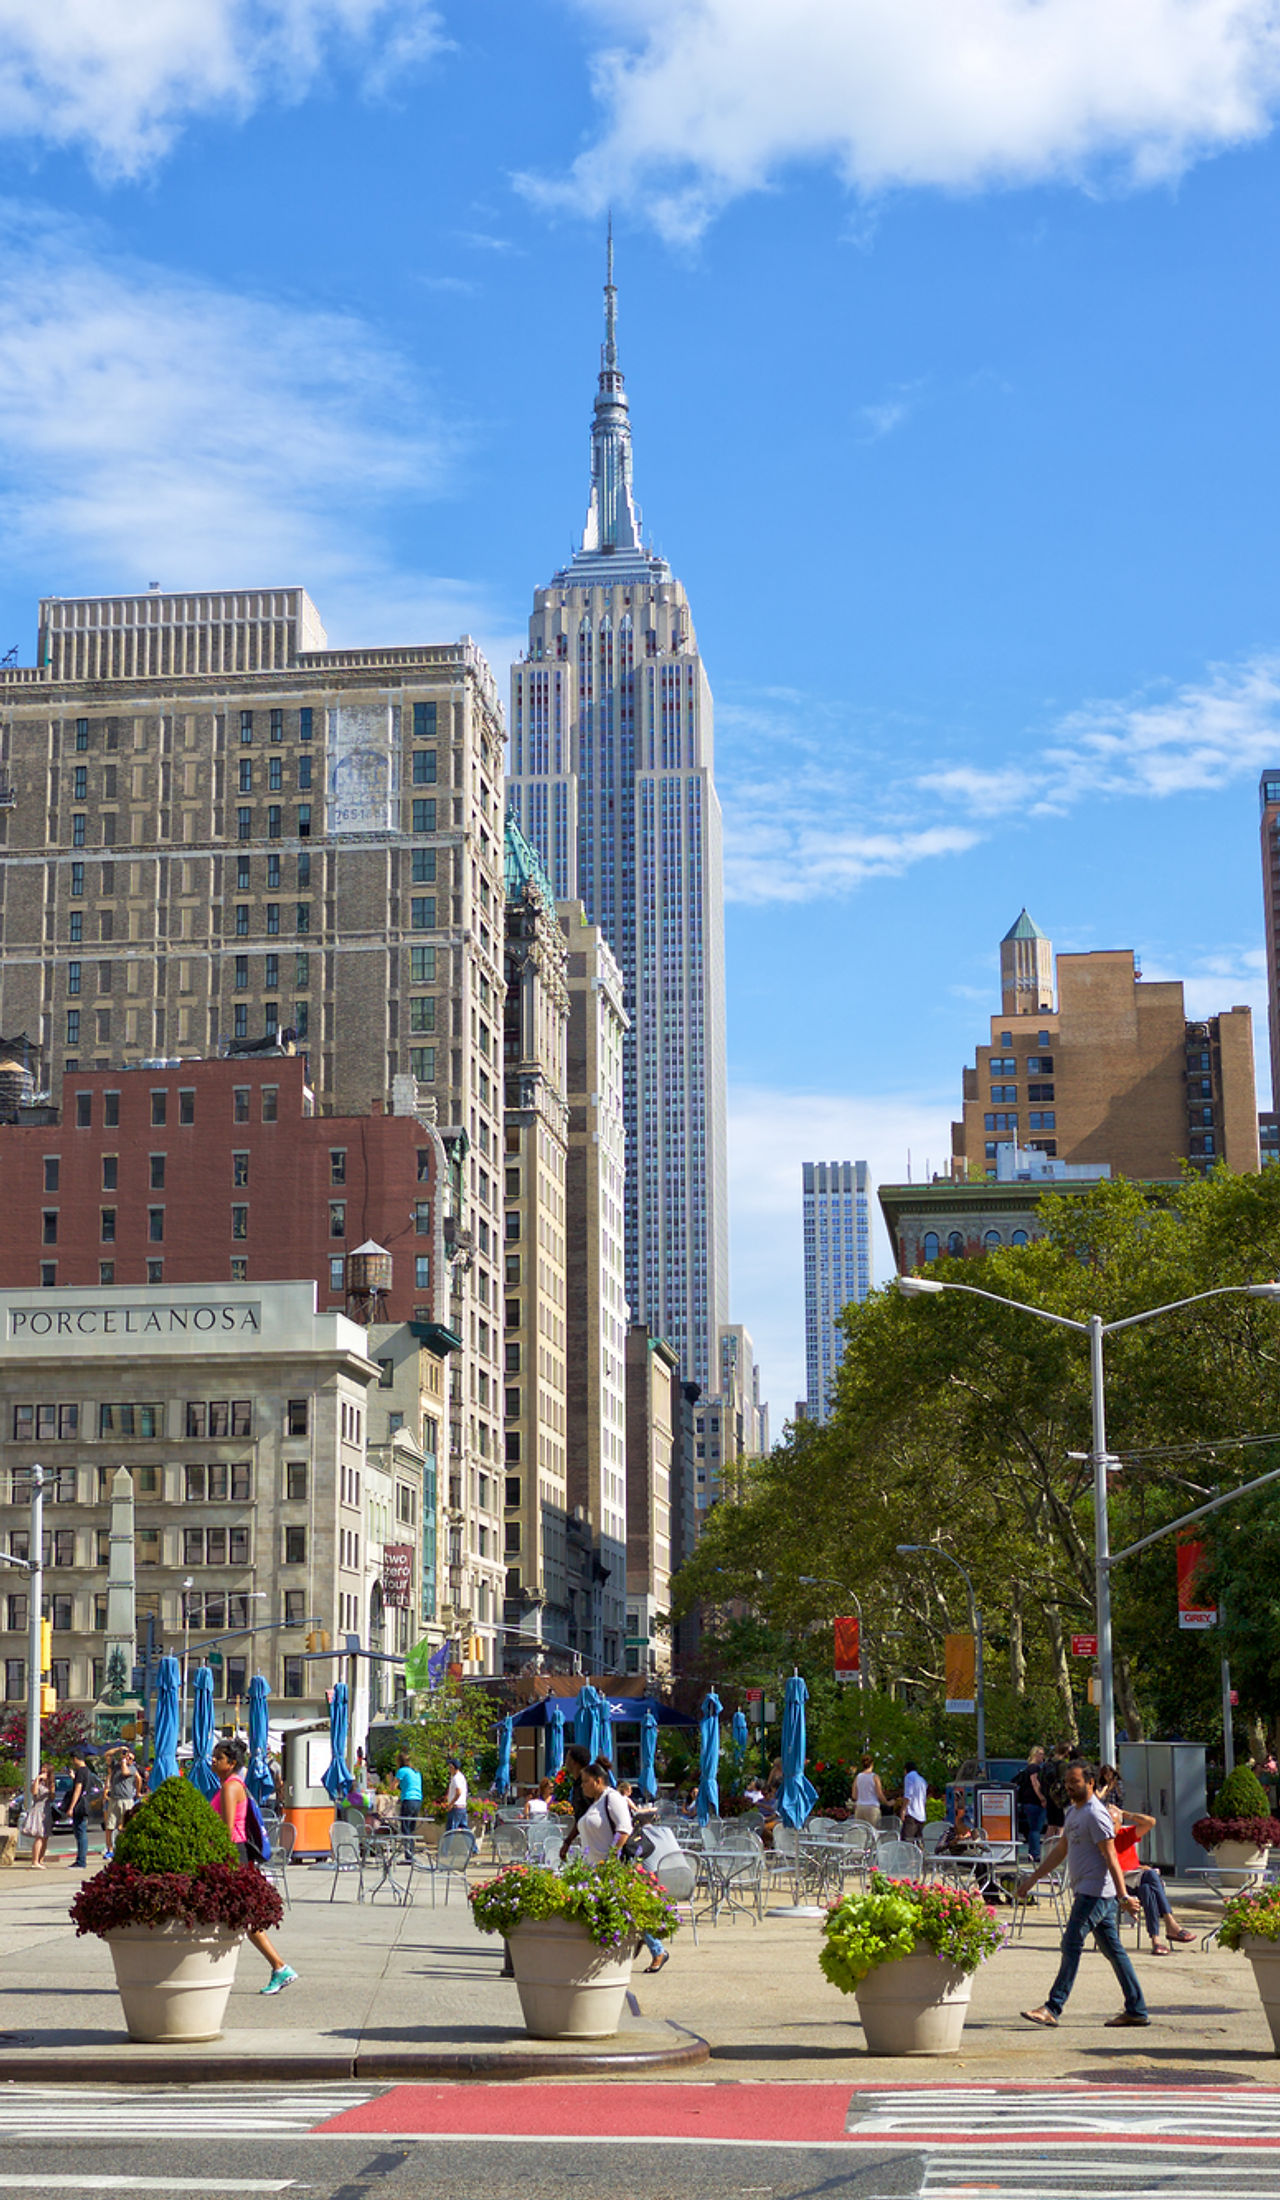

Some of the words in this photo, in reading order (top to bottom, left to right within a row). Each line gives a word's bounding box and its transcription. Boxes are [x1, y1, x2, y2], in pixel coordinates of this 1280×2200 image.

[12, 1308, 260, 1335] PORCELANOSA
[384, 1552, 407, 1565] two
[383, 1566, 410, 1577] zero
[383, 1577, 408, 1589] four
[1184, 1614, 1211, 1623] GREY
